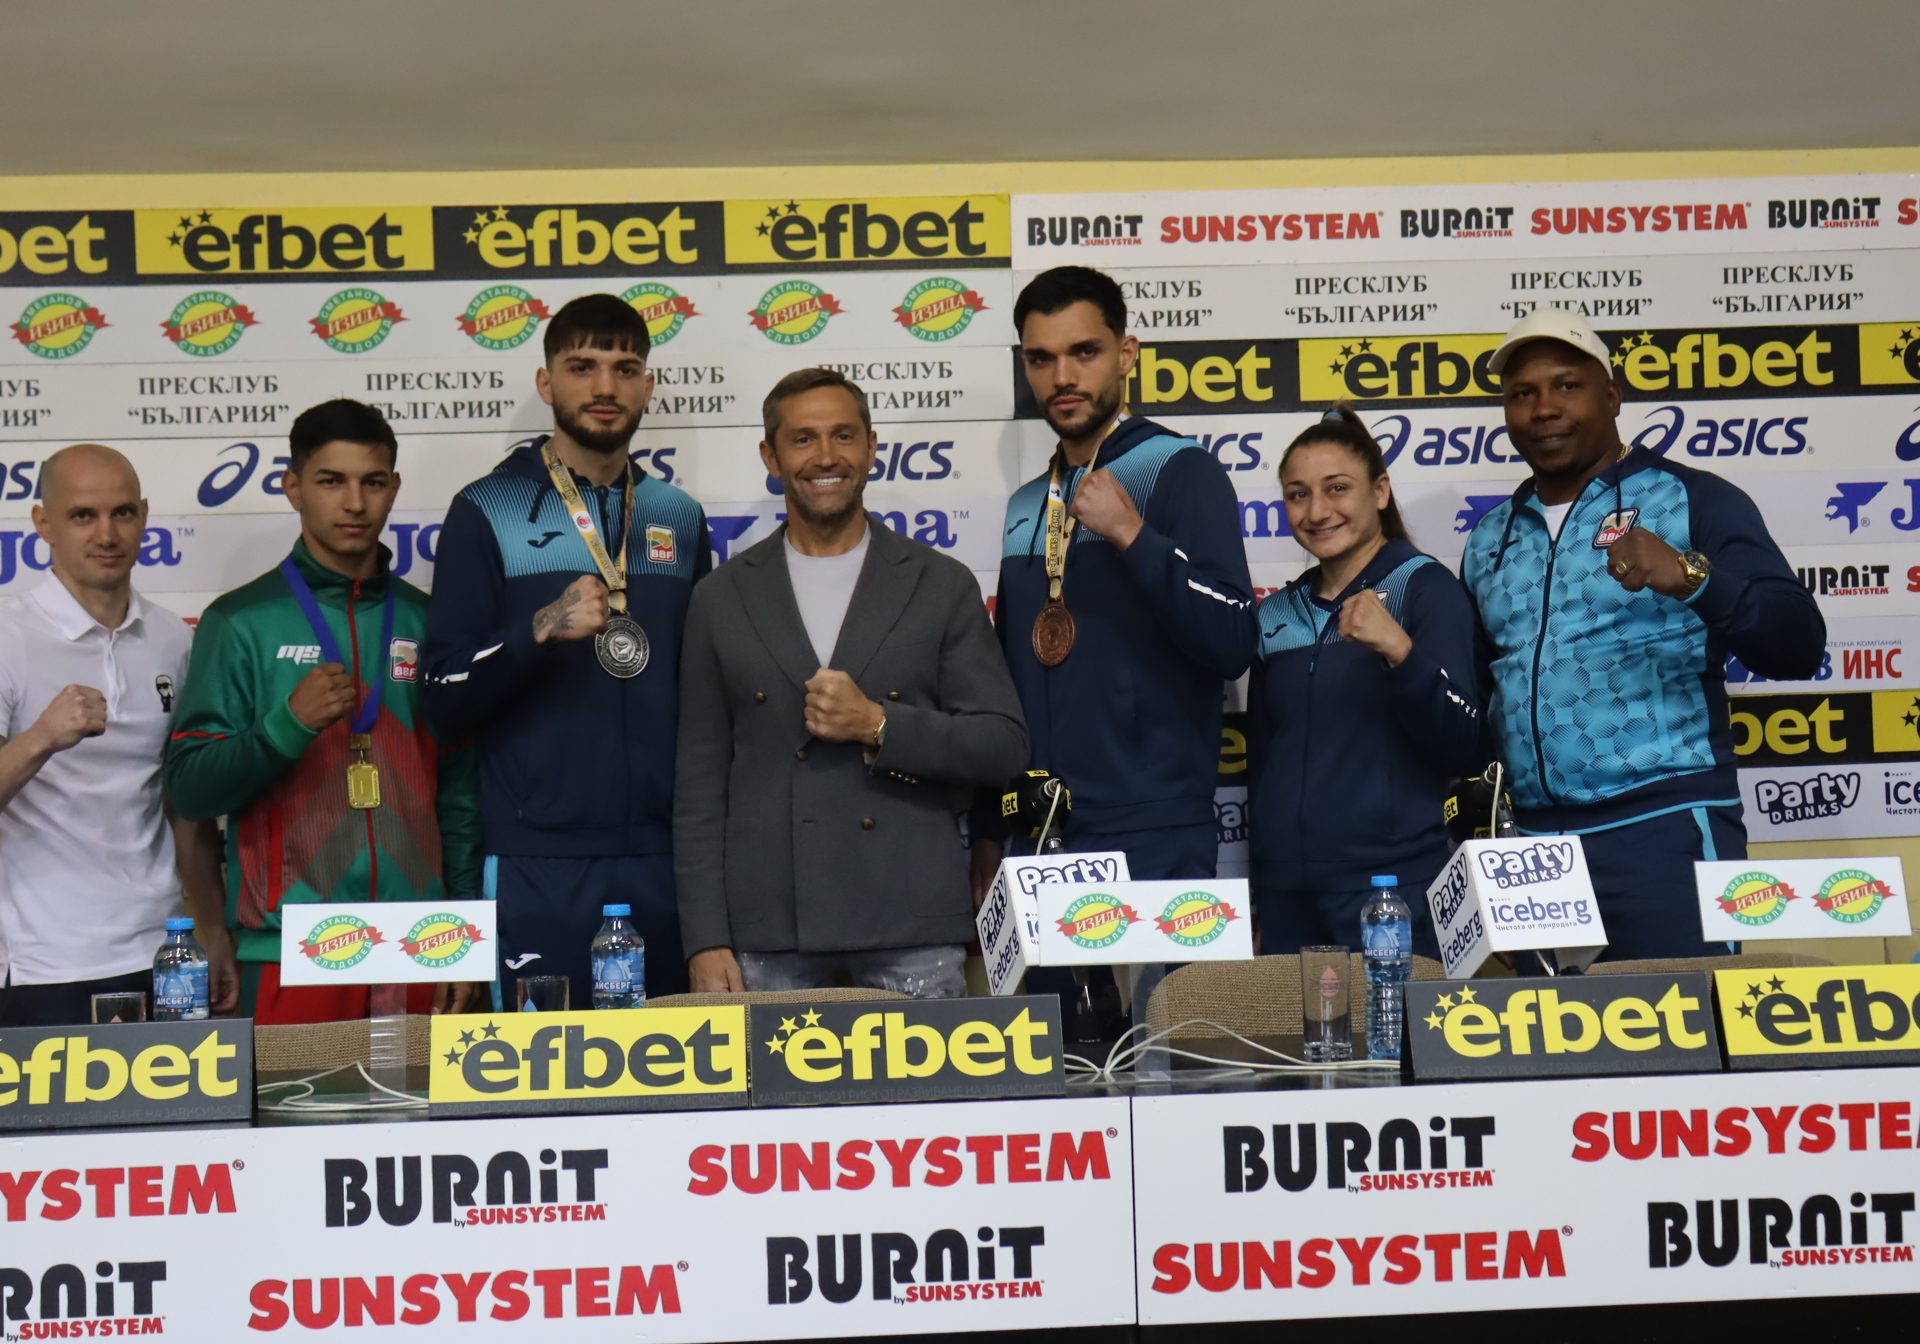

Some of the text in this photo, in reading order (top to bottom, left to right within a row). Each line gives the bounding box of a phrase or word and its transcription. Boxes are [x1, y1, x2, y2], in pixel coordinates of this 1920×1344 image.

[771, 201, 986, 260] efbet
[1160, 212, 1380, 243] SUNSYSTEM
[1531, 203, 1747, 235] SUNSYSTEM
[183, 212, 405, 272] efbet
[477, 207, 698, 268] efbet
[1295, 275, 1427, 295] ПРЕСКЛУБ
[1511, 270, 1642, 290] ПРЕСКЛУБ
[1722, 264, 1853, 285] ПРЕСКЛУБ
[327, 305, 385, 336] ИЗИДА
[475, 302, 532, 333] ИЗИДА
[766, 297, 823, 328] ИЗИДА
[911, 293, 967, 325] ИЗИДА
[29, 311, 88, 342] ИЗИДА
[179, 308, 238, 339] ИЗИДА
[1343, 342, 1503, 398] efbe
[1623, 330, 1833, 391] efbet
[139, 375, 279, 395] ПРЕСКЛУБ
[366, 371, 504, 391] ПРЕСКЛУБ
[651, 550, 673, 560] BBF
[394, 665, 416, 677] BBF
[1843, 648, 1902, 680] ИНС
[1755, 772, 1861, 814] Party
[1771, 802, 1841, 824] DRINKS
[1478, 842, 1573, 881] Party
[1497, 868, 1561, 889] DRINKS
[1725, 873, 1775, 897] СМЕТАНОВ
[1821, 871, 1871, 895] СМЕТАНОВ
[1066, 895, 1117, 919] СМЕТАНОВ
[1164, 893, 1216, 917] СМЕТАНОВ
[1735, 884, 1784, 911] ИЗИДА
[1828, 894, 1883, 922] СЛАДОЛЕД
[1831, 882, 1880, 908] ИЗИДА
[1075, 908, 1125, 933] ИЗИДА
[1173, 905, 1224, 931] ИЗИДА
[1490, 896, 1592, 925] iceberg
[1733, 896, 1787, 925] СЛАДОЛЕД
[310, 916, 363, 941] СМЕТАНОВ
[409, 914, 463, 939] СМЕТАНОВ
[418, 927, 470, 952] ИЗИДА
[1072, 919, 1129, 948] СЛАДОЛЕД
[1171, 917, 1227, 946] СЛАДОЛЕД
[1442, 910, 1483, 969] iceberg
[314, 941, 373, 969] СЛАДОЛЕД
[318, 929, 370, 954] ИЗИДА
[414, 939, 472, 967] СЛАДОЛЕД
[990, 926, 1020, 995] iceberg
[1442, 983, 1708, 1058] efbet
[461, 1018, 733, 1094] efbet
[784, 1007, 1053, 1083] efbet
[1572, 1101, 1920, 1162] SUNSYSTE
[687, 1130, 1111, 1196] SUNSYSTEM
[1348, 1169, 1494, 1195] by SUNSYSTEM
[454, 1204, 606, 1228] by SUNSYSTEM
[1152, 1229, 1566, 1294] SUNSYSTEM
[1770, 1246, 1913, 1270] by SUNSYSTEM
[247, 1264, 682, 1332] SUNSYSTEM
[893, 1281, 1043, 1305] by SUNSYSTEM
[6, 1317, 164, 1342] by SUNSYSTEM
